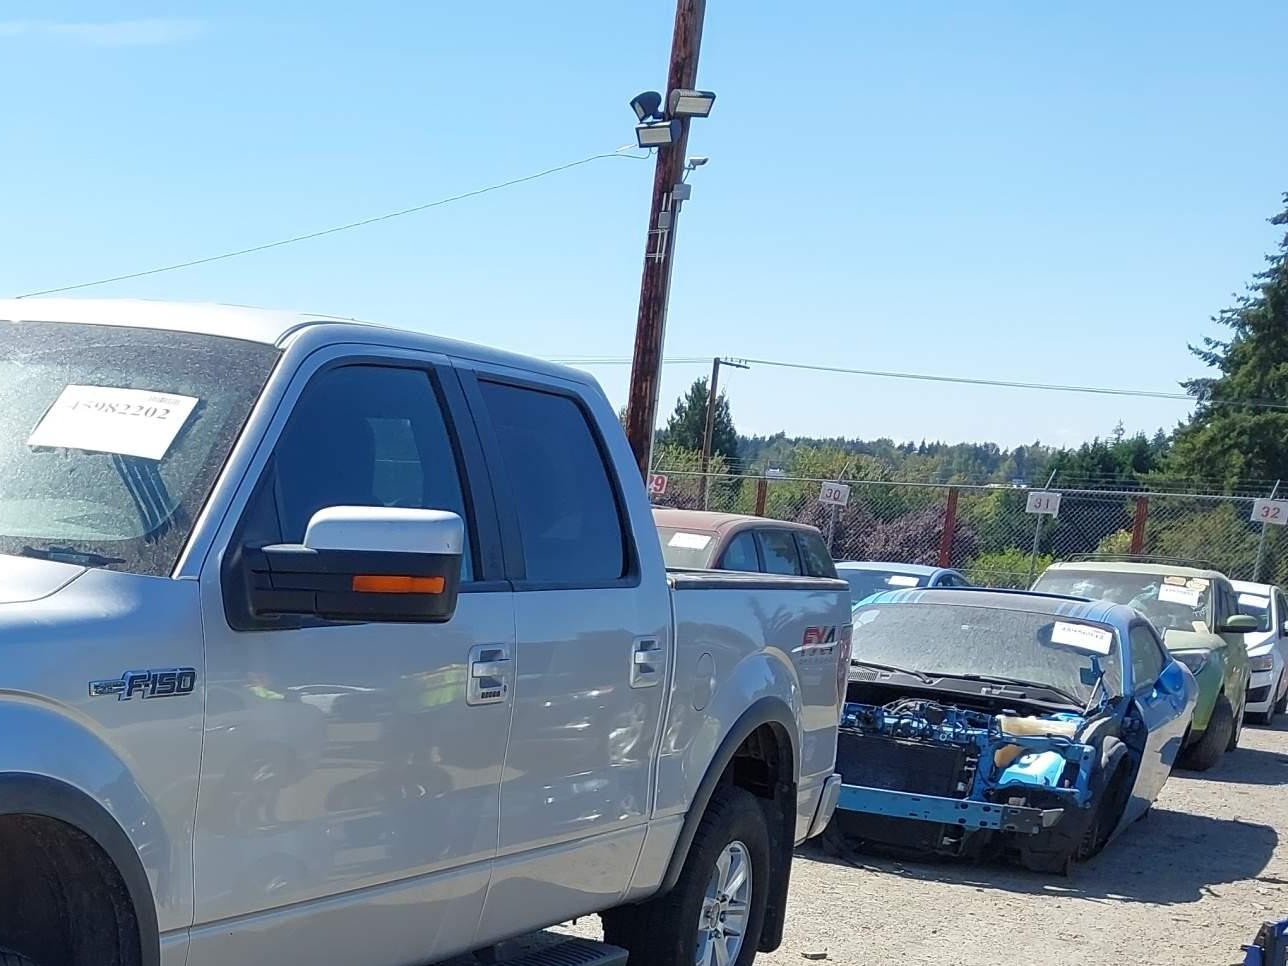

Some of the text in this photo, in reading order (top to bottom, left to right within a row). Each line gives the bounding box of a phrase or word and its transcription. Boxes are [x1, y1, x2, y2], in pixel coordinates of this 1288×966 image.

[825, 488, 841, 501] 30
[1034, 498, 1050, 509] 31
[1261, 505, 1281, 519] 32
